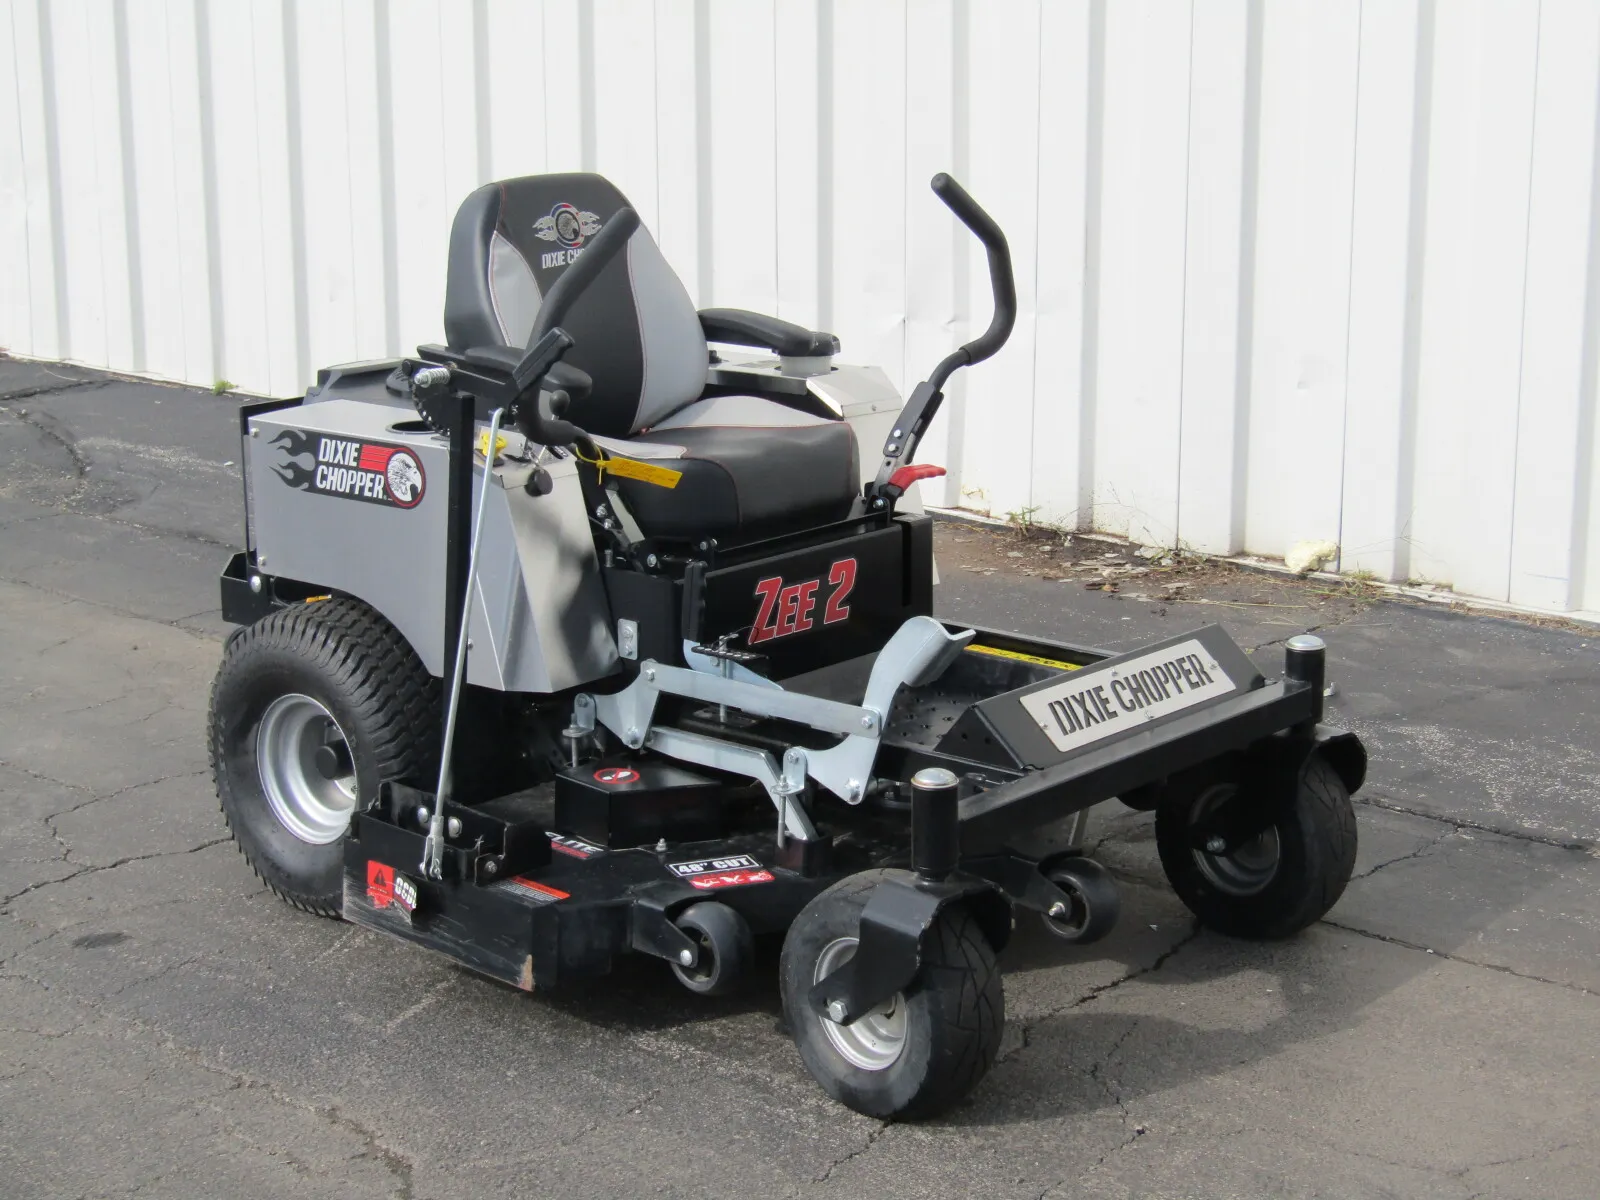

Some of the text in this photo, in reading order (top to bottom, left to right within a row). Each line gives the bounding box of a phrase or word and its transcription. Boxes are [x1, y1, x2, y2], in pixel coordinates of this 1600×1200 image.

[541, 252, 566, 270] DIXIE
[318, 438, 360, 468] DIXIE
[315, 465, 385, 500] CHOPPER
[748, 558, 857, 645] ZEE 2
[1047, 653, 1215, 737] DIXIE CHOPPER
[712, 857, 751, 870] CUT
